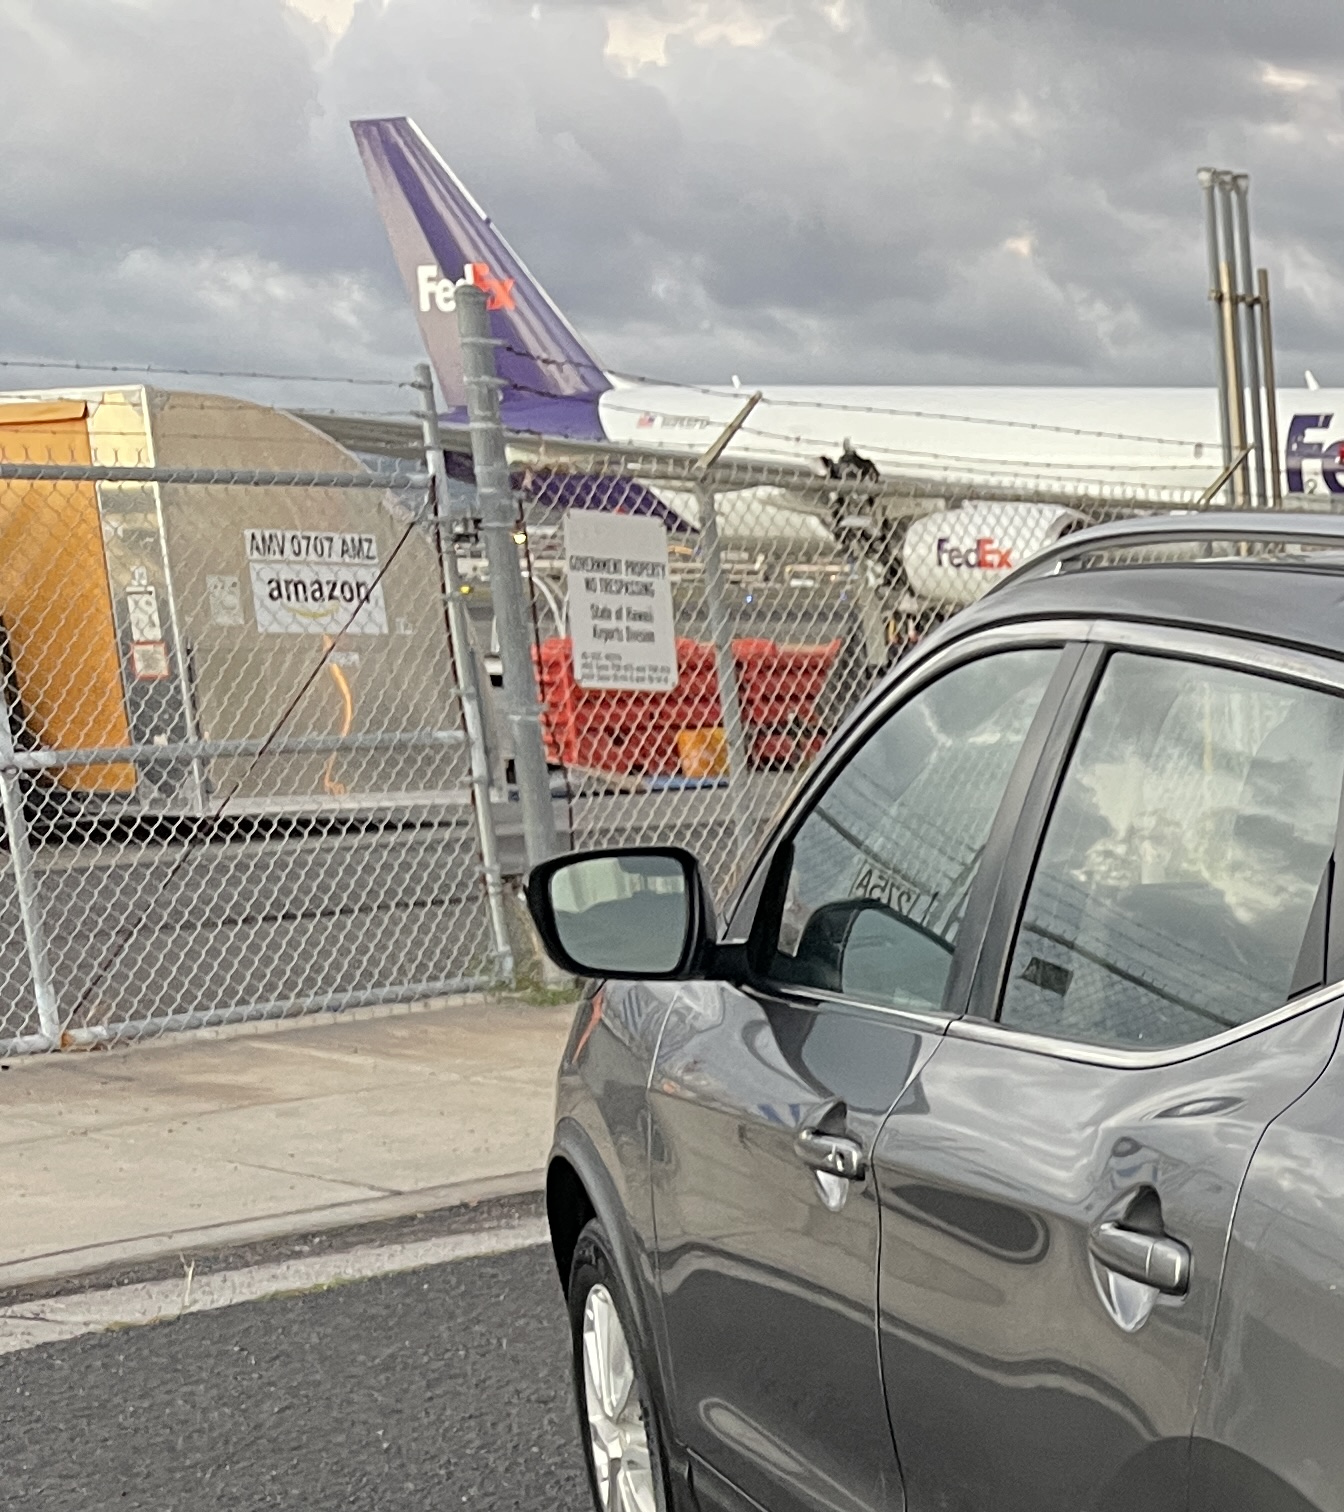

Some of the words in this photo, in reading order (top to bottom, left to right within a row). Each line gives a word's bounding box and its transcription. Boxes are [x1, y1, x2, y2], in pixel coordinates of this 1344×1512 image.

[249, 531, 286, 557] AMV
[290, 533, 334, 559] 0707
[340, 535, 377, 560] AMZ
[936, 537, 1013, 569] FedEx
[569, 554, 623, 575] GOVERNMENT
[624, 559, 666, 580] PROPERTY
[267, 578, 371, 604] amazon
[583, 577, 598, 593] NO
[598, 577, 655, 598] TRESPASSING
[590, 603, 612, 621] State
[614, 605, 624, 621] of
